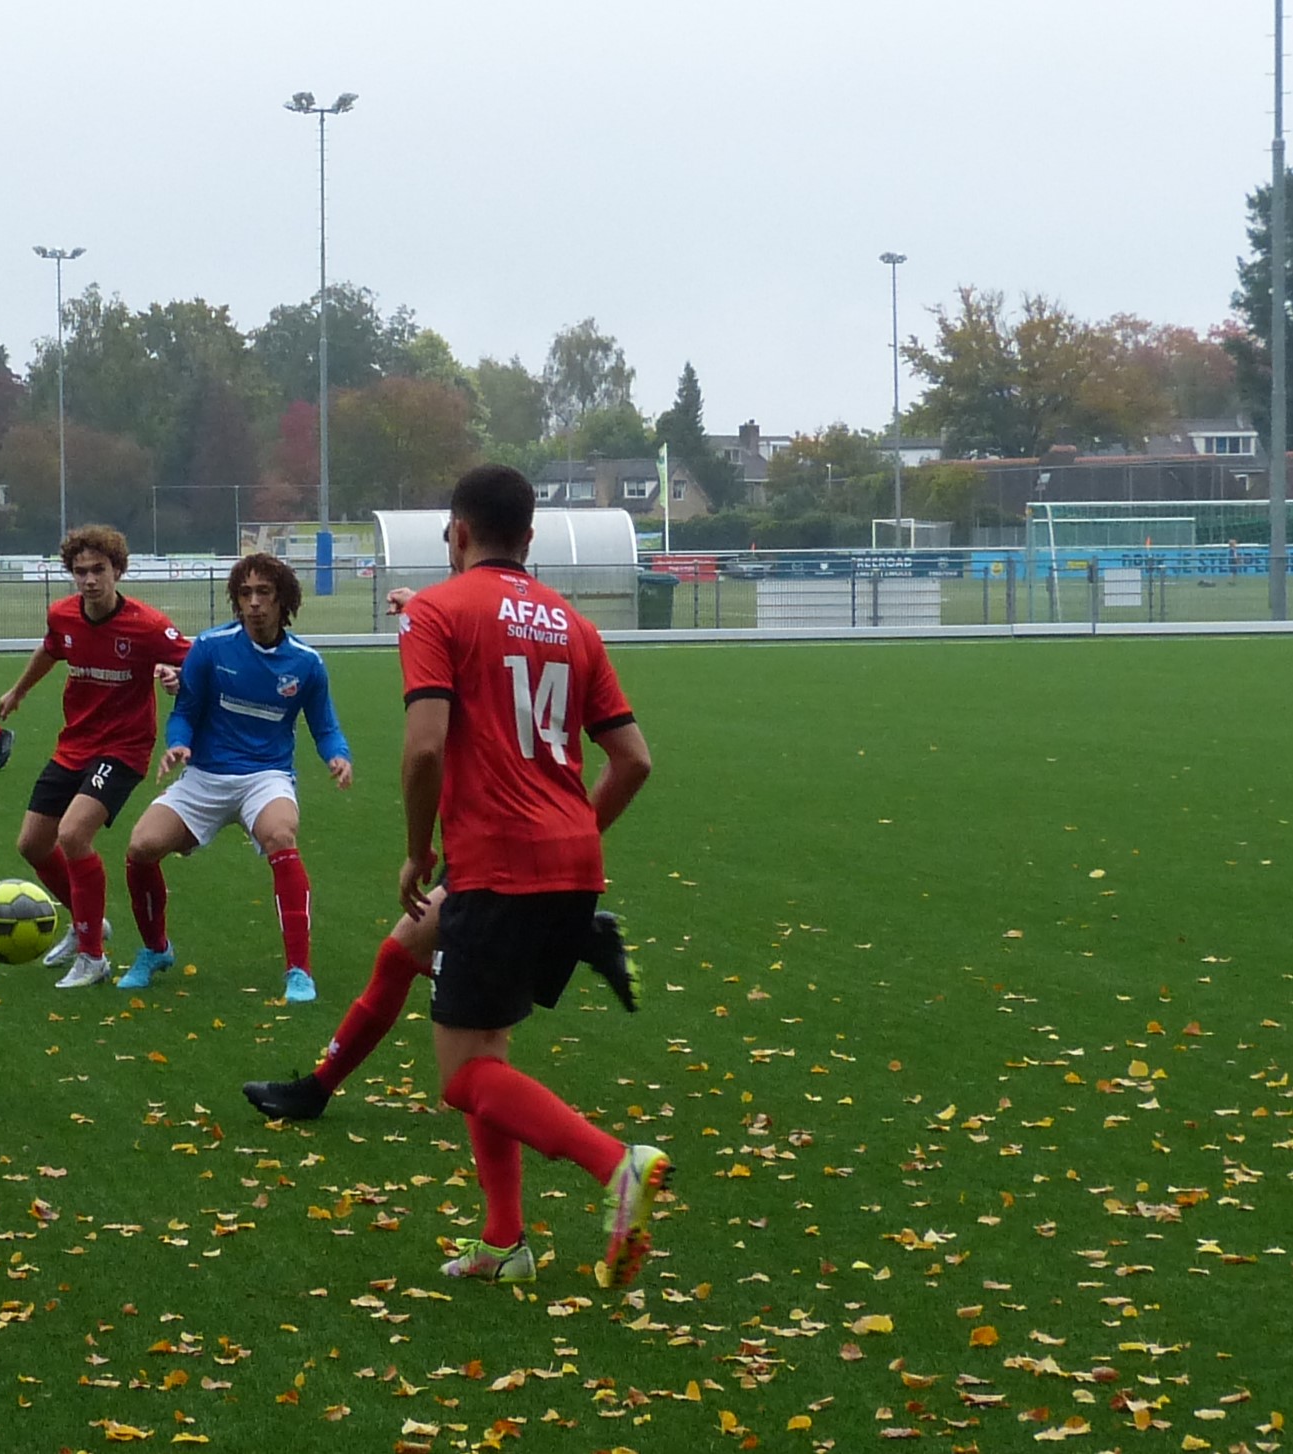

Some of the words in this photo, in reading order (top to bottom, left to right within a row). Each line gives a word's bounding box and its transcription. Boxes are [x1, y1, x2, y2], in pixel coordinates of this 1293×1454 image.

[498, 597, 568, 631] AFAS
[507, 624, 568, 645] software
[503, 655, 569, 765] 14
[97, 763, 113, 777] 12
